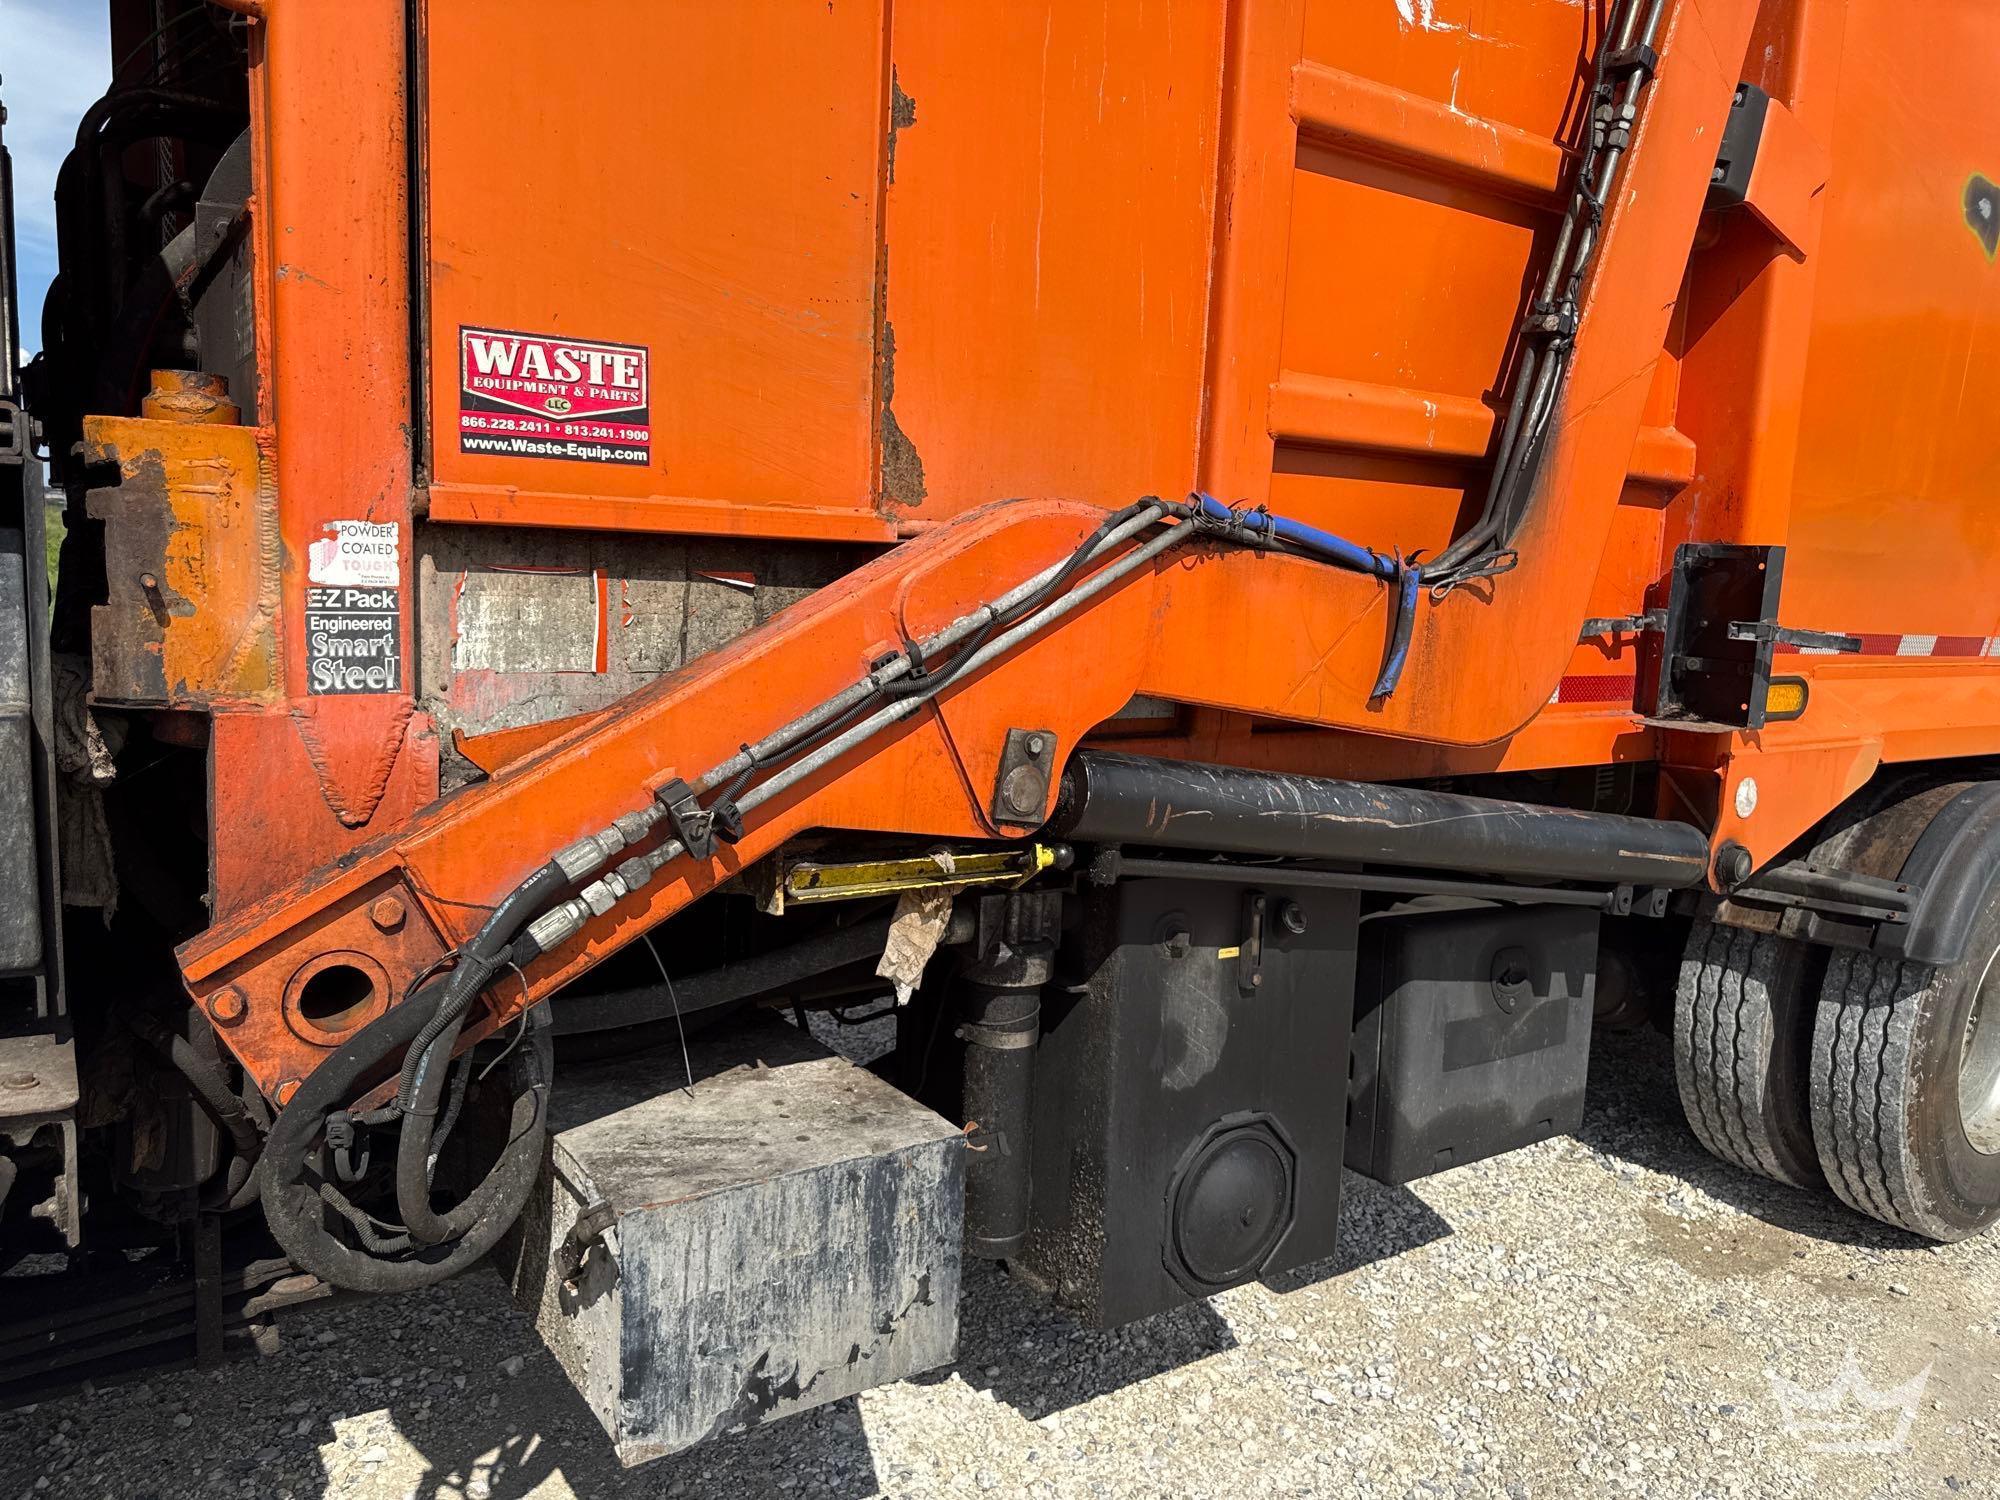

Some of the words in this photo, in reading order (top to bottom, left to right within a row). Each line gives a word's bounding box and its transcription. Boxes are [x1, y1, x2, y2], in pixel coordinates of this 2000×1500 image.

[468, 337, 640, 389] WASTE
[473, 376, 568, 395] EQUIPMENT
[573, 386, 584, 397] &
[589, 387, 640, 402] PARTS
[547, 399, 568, 410] LLC
[461, 415, 550, 433] 866.228.2411
[564, 425, 649, 441] 813.241.1900
[463, 438, 648, 461] www.Waste-Equip.com
[341, 525, 393, 538] POWDER
[341, 542, 393, 555] COATED
[342, 559, 393, 572] TOUGH
[344, 589, 396, 609] Pack
[310, 616, 392, 634] Engineered
[312, 632, 394, 657] Smart
[312, 657, 395, 690] Steel
